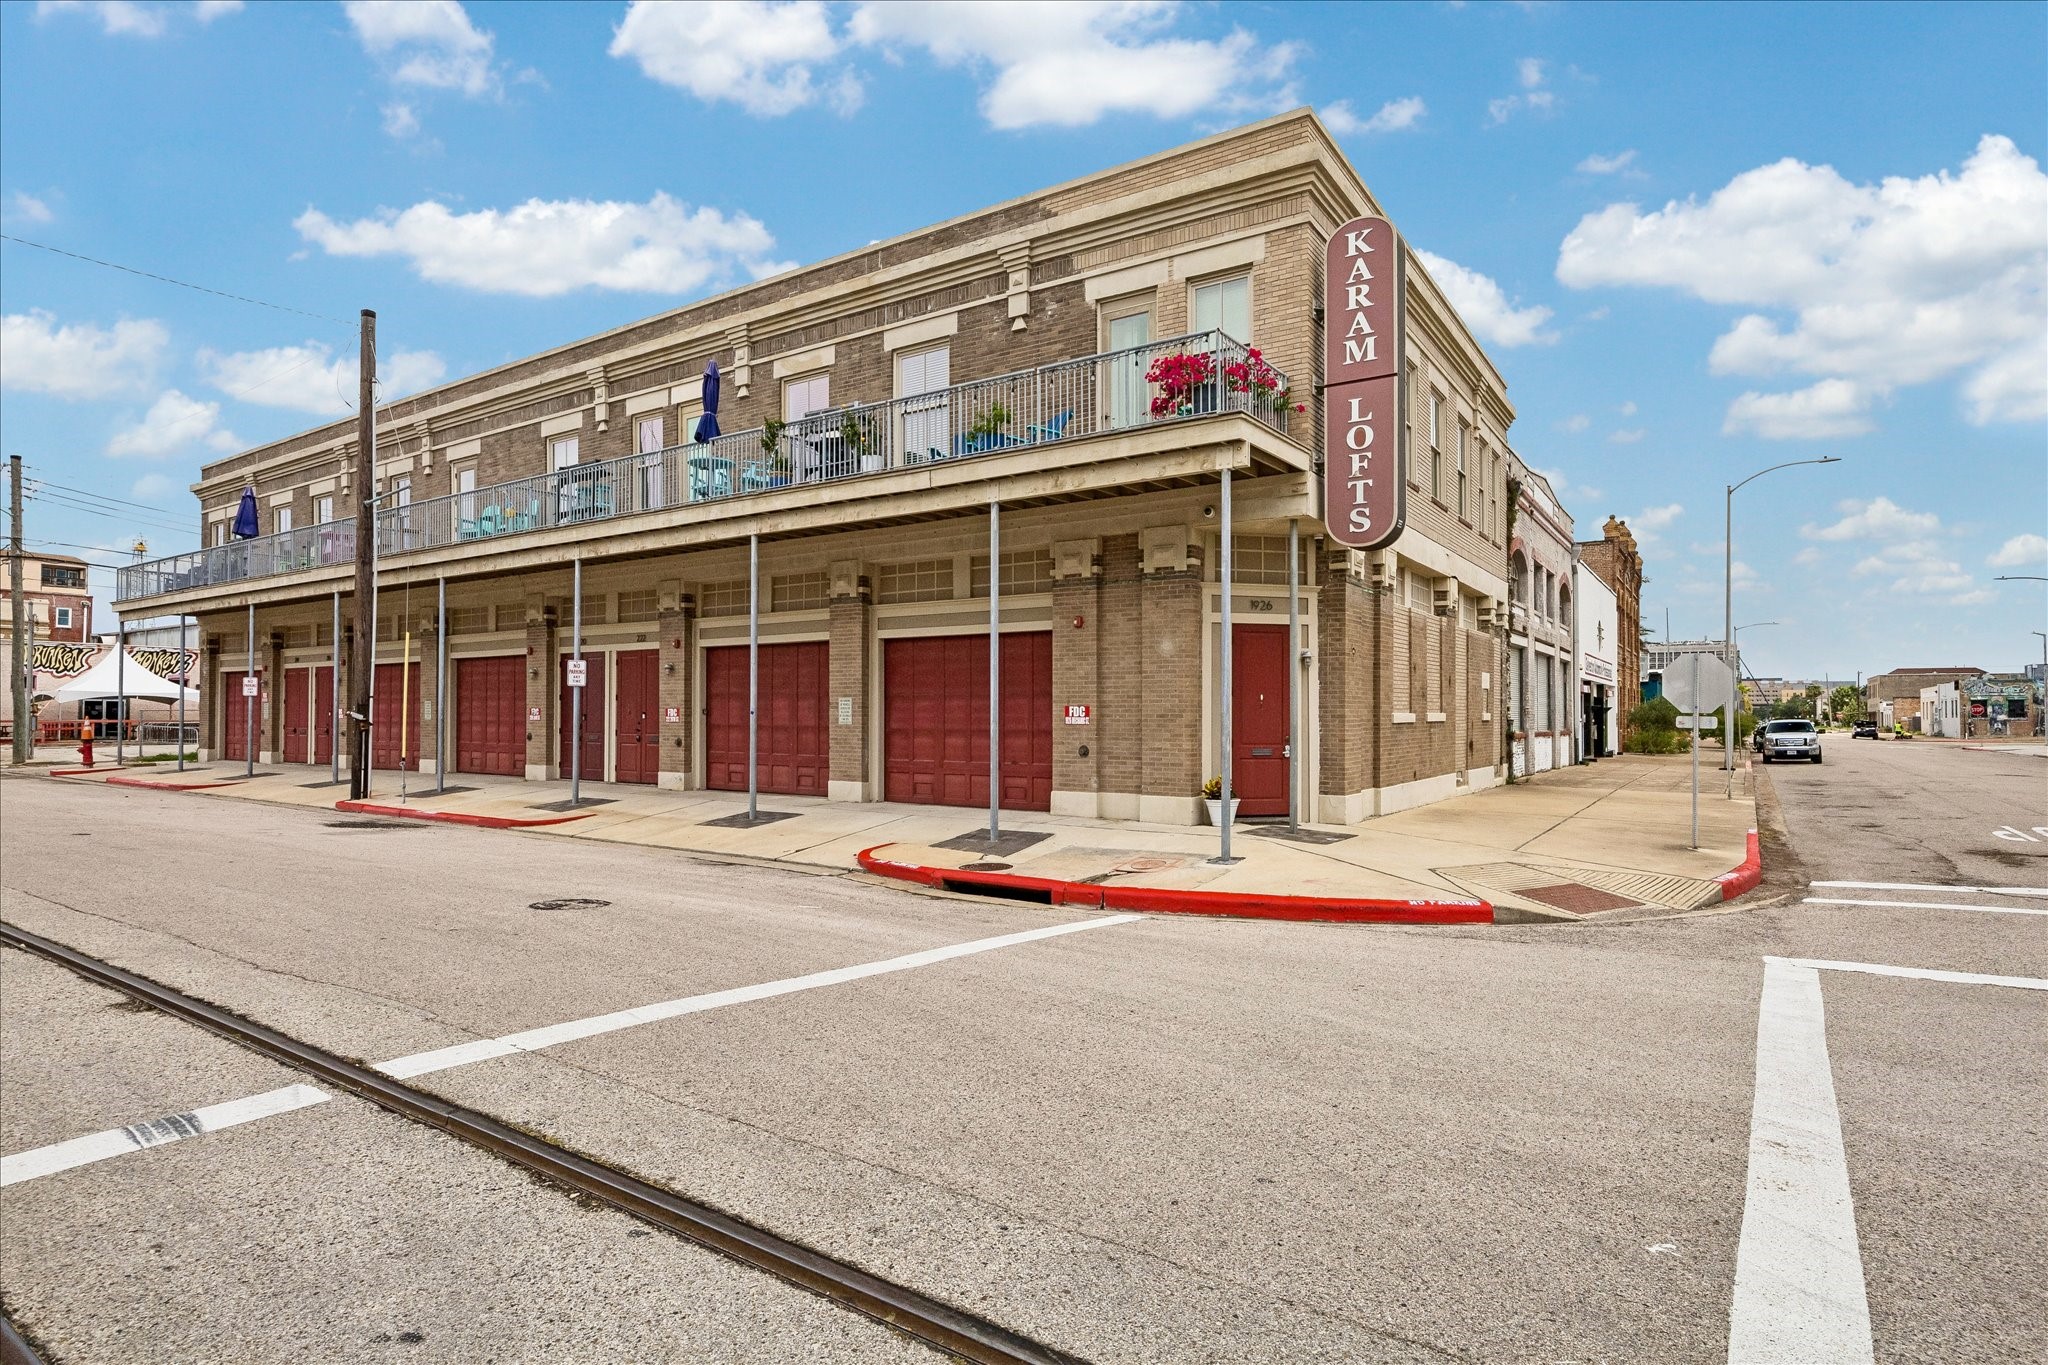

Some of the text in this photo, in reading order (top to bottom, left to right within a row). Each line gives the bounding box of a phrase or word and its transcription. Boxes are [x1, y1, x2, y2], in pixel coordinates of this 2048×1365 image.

[1343, 227, 1378, 533] KARAM LOFTS
[1250, 599, 1273, 611] 1926
[636, 634, 647, 642] 222
[667, 708, 678, 717] FDC
[1069, 705, 1086, 717] FDC
